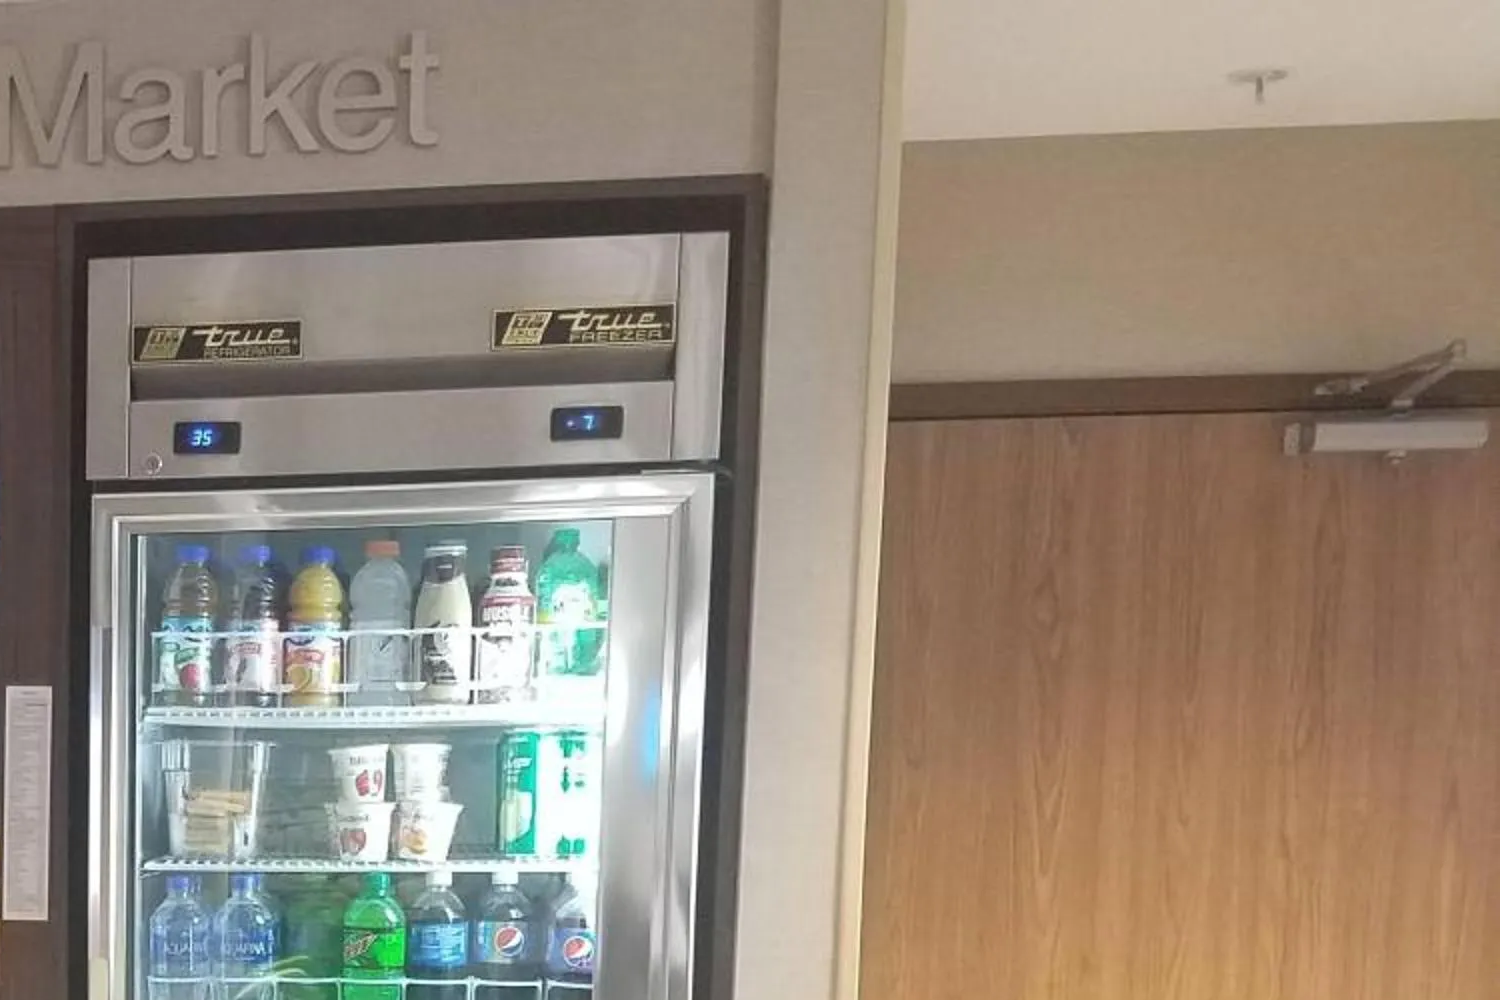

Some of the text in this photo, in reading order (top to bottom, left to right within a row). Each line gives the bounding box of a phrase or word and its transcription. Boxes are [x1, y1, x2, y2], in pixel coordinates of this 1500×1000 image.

[557, 309, 663, 331] true
[192, 325, 292, 347] true
[569, 329, 663, 344] FREEZER
[191, 429, 213, 447] 35
